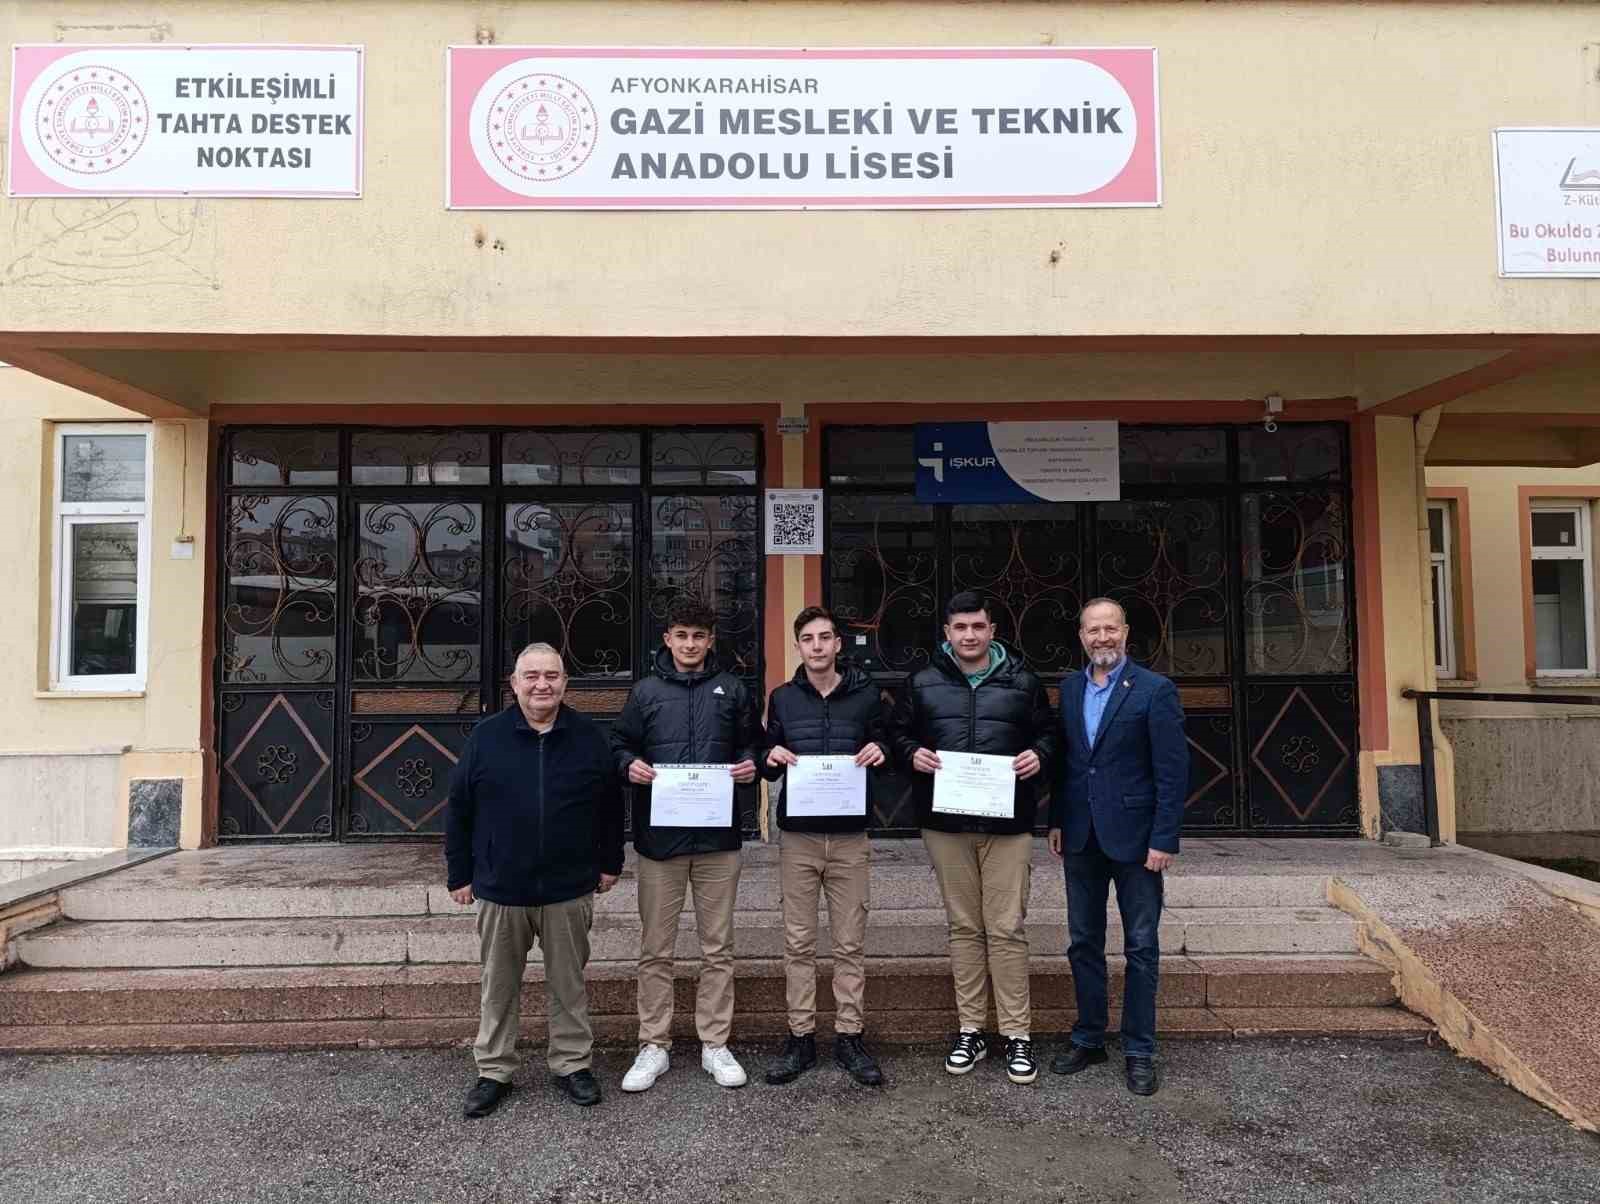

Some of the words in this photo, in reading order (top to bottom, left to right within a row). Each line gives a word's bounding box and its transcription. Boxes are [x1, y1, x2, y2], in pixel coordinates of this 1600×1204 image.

[176, 73, 335, 105] ETKİLEŞİMLİ
[610, 75, 818, 94] AFYONKARAHİSAR
[157, 113, 243, 134] TAHTA
[251, 113, 352, 135] DESTEK
[610, 101, 704, 136] GAZİ
[719, 101, 893, 136] MESLEKİ
[907, 108, 959, 135] VE
[971, 101, 1123, 135] TEKNİK
[197, 146, 311, 169] NOKTASI
[610, 152, 809, 180] ANADOLU
[825, 145, 953, 180] LİSESİ
[1510, 224, 1529, 238] Bu
[1535, 223, 1592, 238] Okulda
